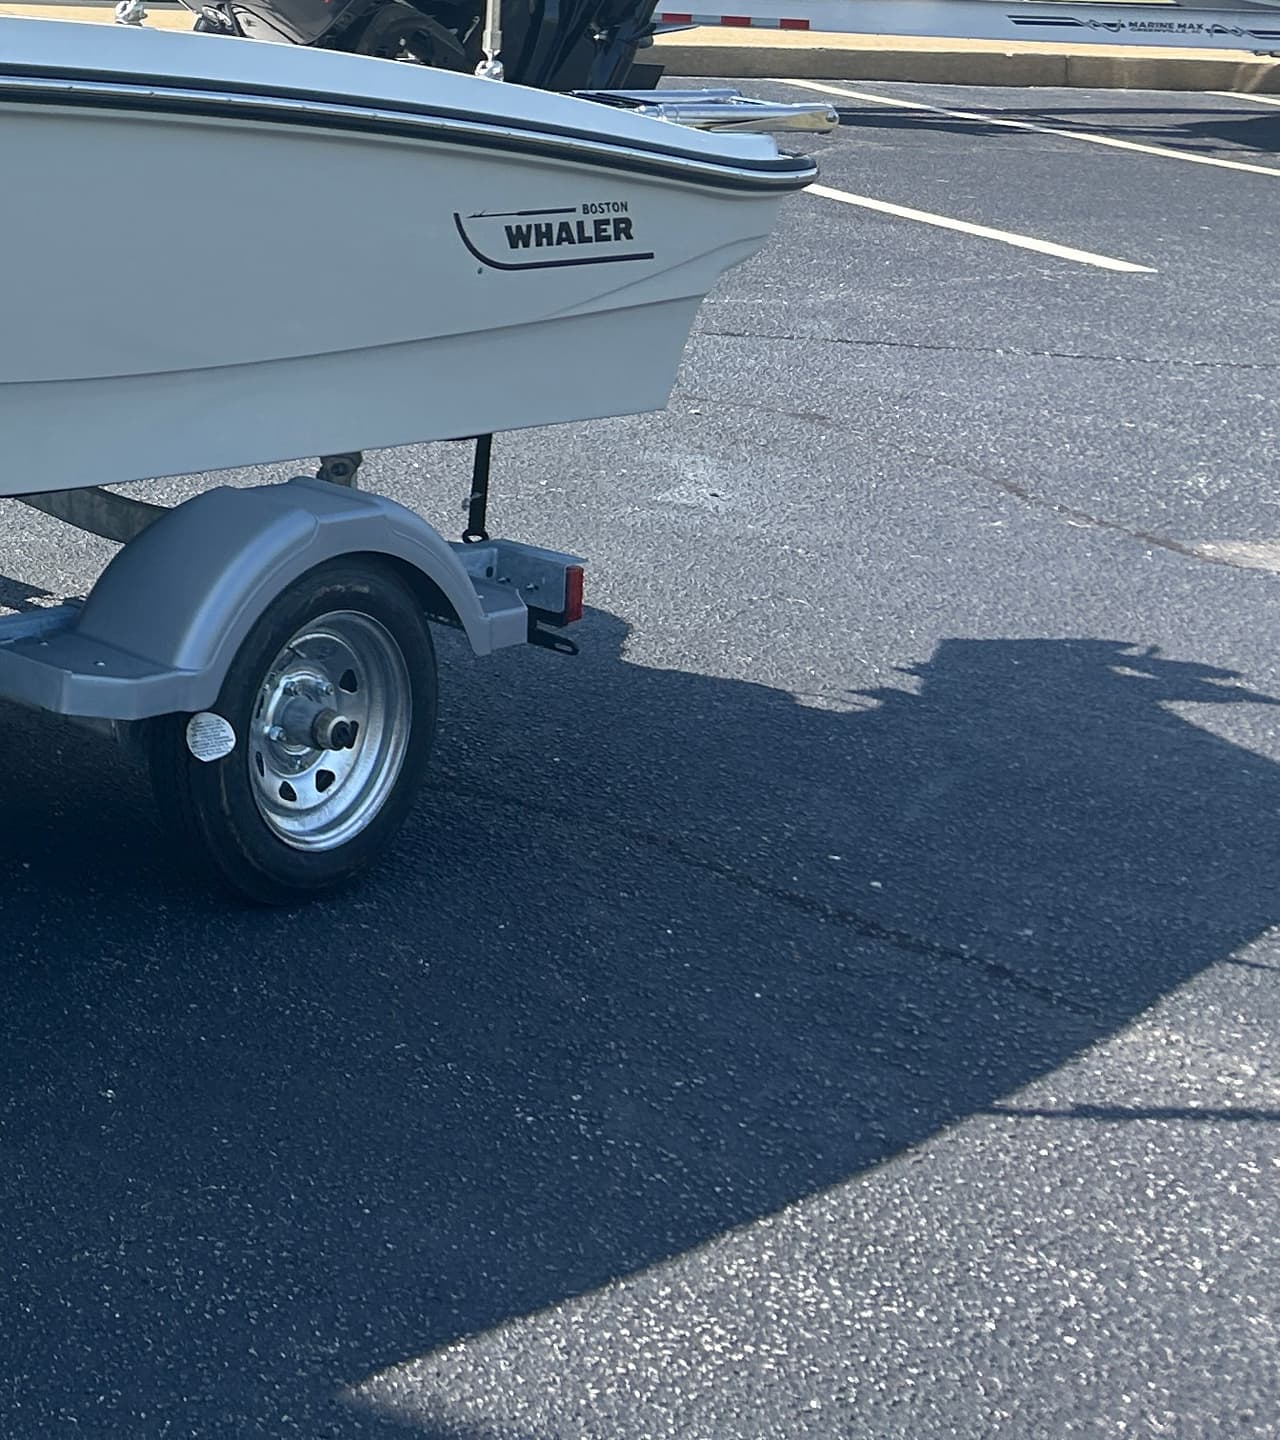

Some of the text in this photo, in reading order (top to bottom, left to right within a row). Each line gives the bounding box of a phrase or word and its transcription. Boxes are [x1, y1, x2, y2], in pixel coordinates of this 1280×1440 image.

[1128, 21, 1175, 29] MARINE
[581, 201, 628, 215] BOSTON
[504, 217, 633, 249] WHALER
